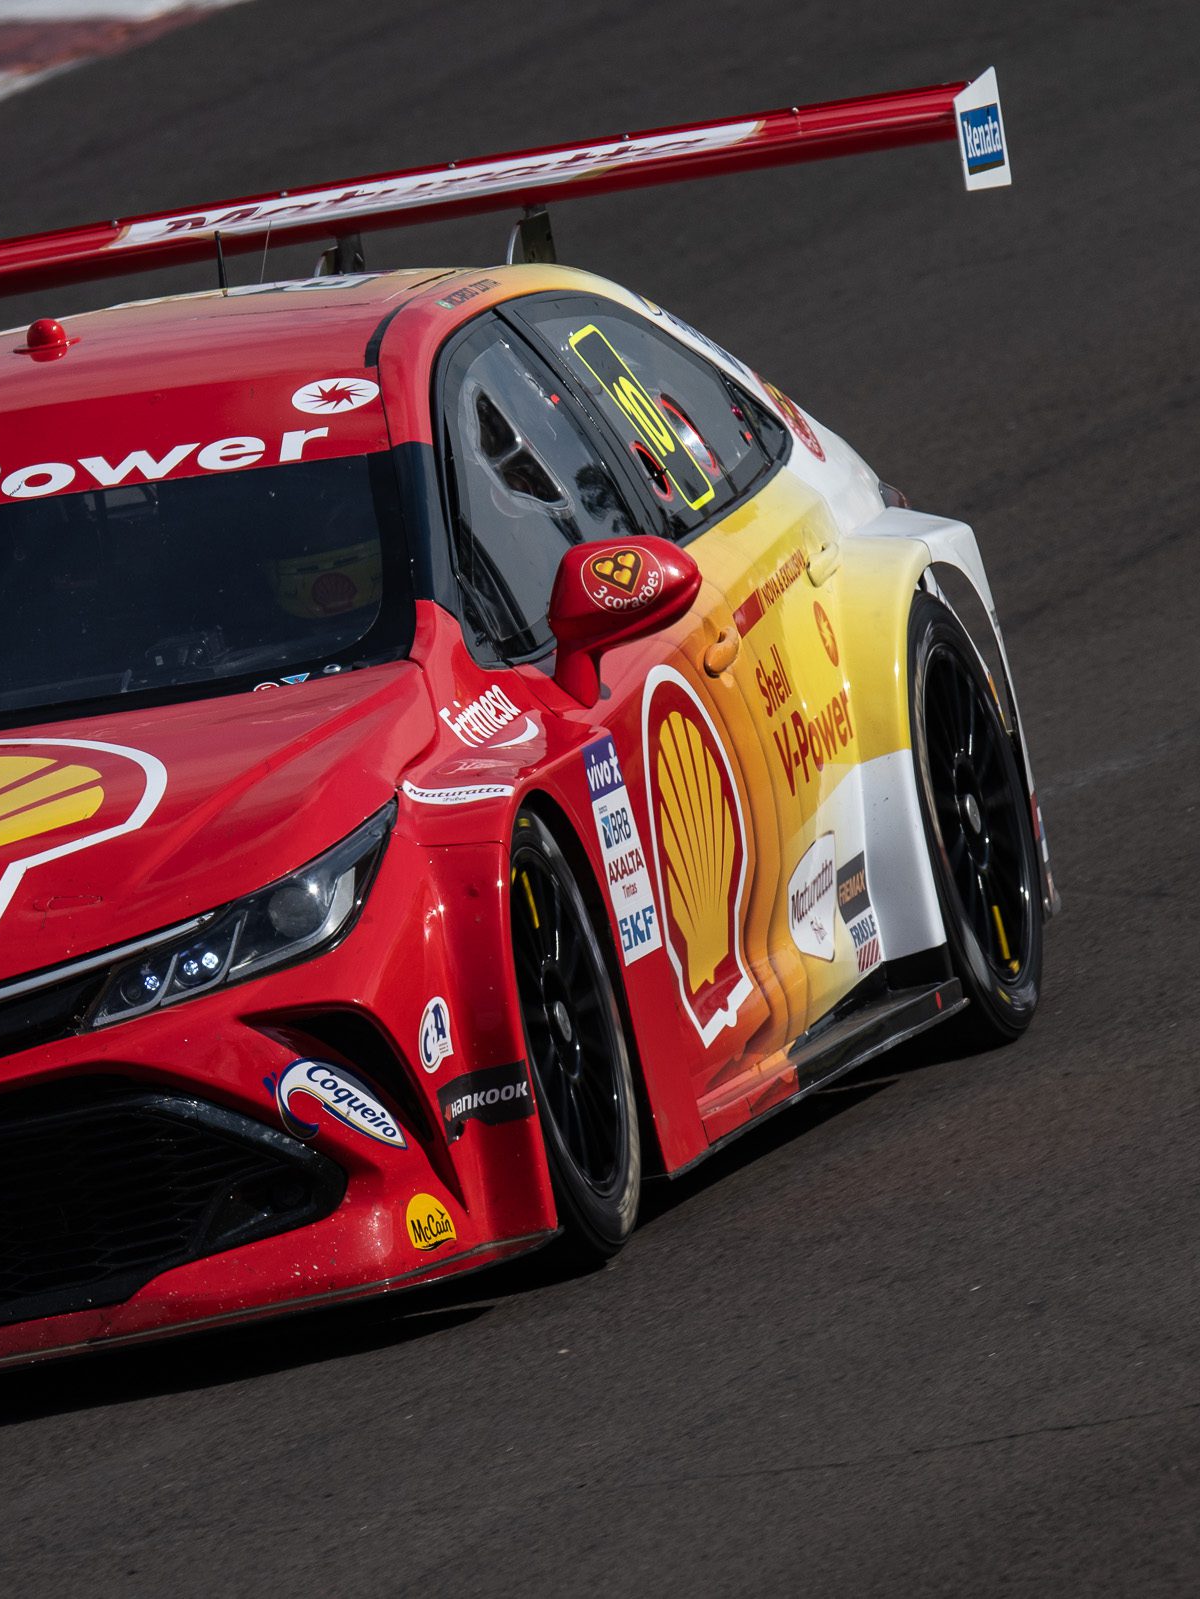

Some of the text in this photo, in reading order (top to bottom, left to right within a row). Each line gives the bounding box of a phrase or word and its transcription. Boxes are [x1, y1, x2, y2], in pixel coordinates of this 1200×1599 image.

[963, 115, 1002, 159] Renata
[612, 375, 676, 457] 10
[593, 570, 660, 610] 3 corações
[755, 643, 792, 718] Shell
[438, 684, 522, 748] Frimesa
[773, 688, 854, 797] V-Power
[408, 787, 506, 799] Maturatta
[587, 753, 611, 793] vivo
[610, 806, 632, 845] BRB
[608, 847, 645, 886] AXALTA
[622, 882, 638, 899] Tintas
[838, 868, 867, 907] FREMAX
[618, 904, 654, 952] SKF
[306, 1064, 397, 1139] Coqueiro
[410, 1209, 453, 1244] McCain
